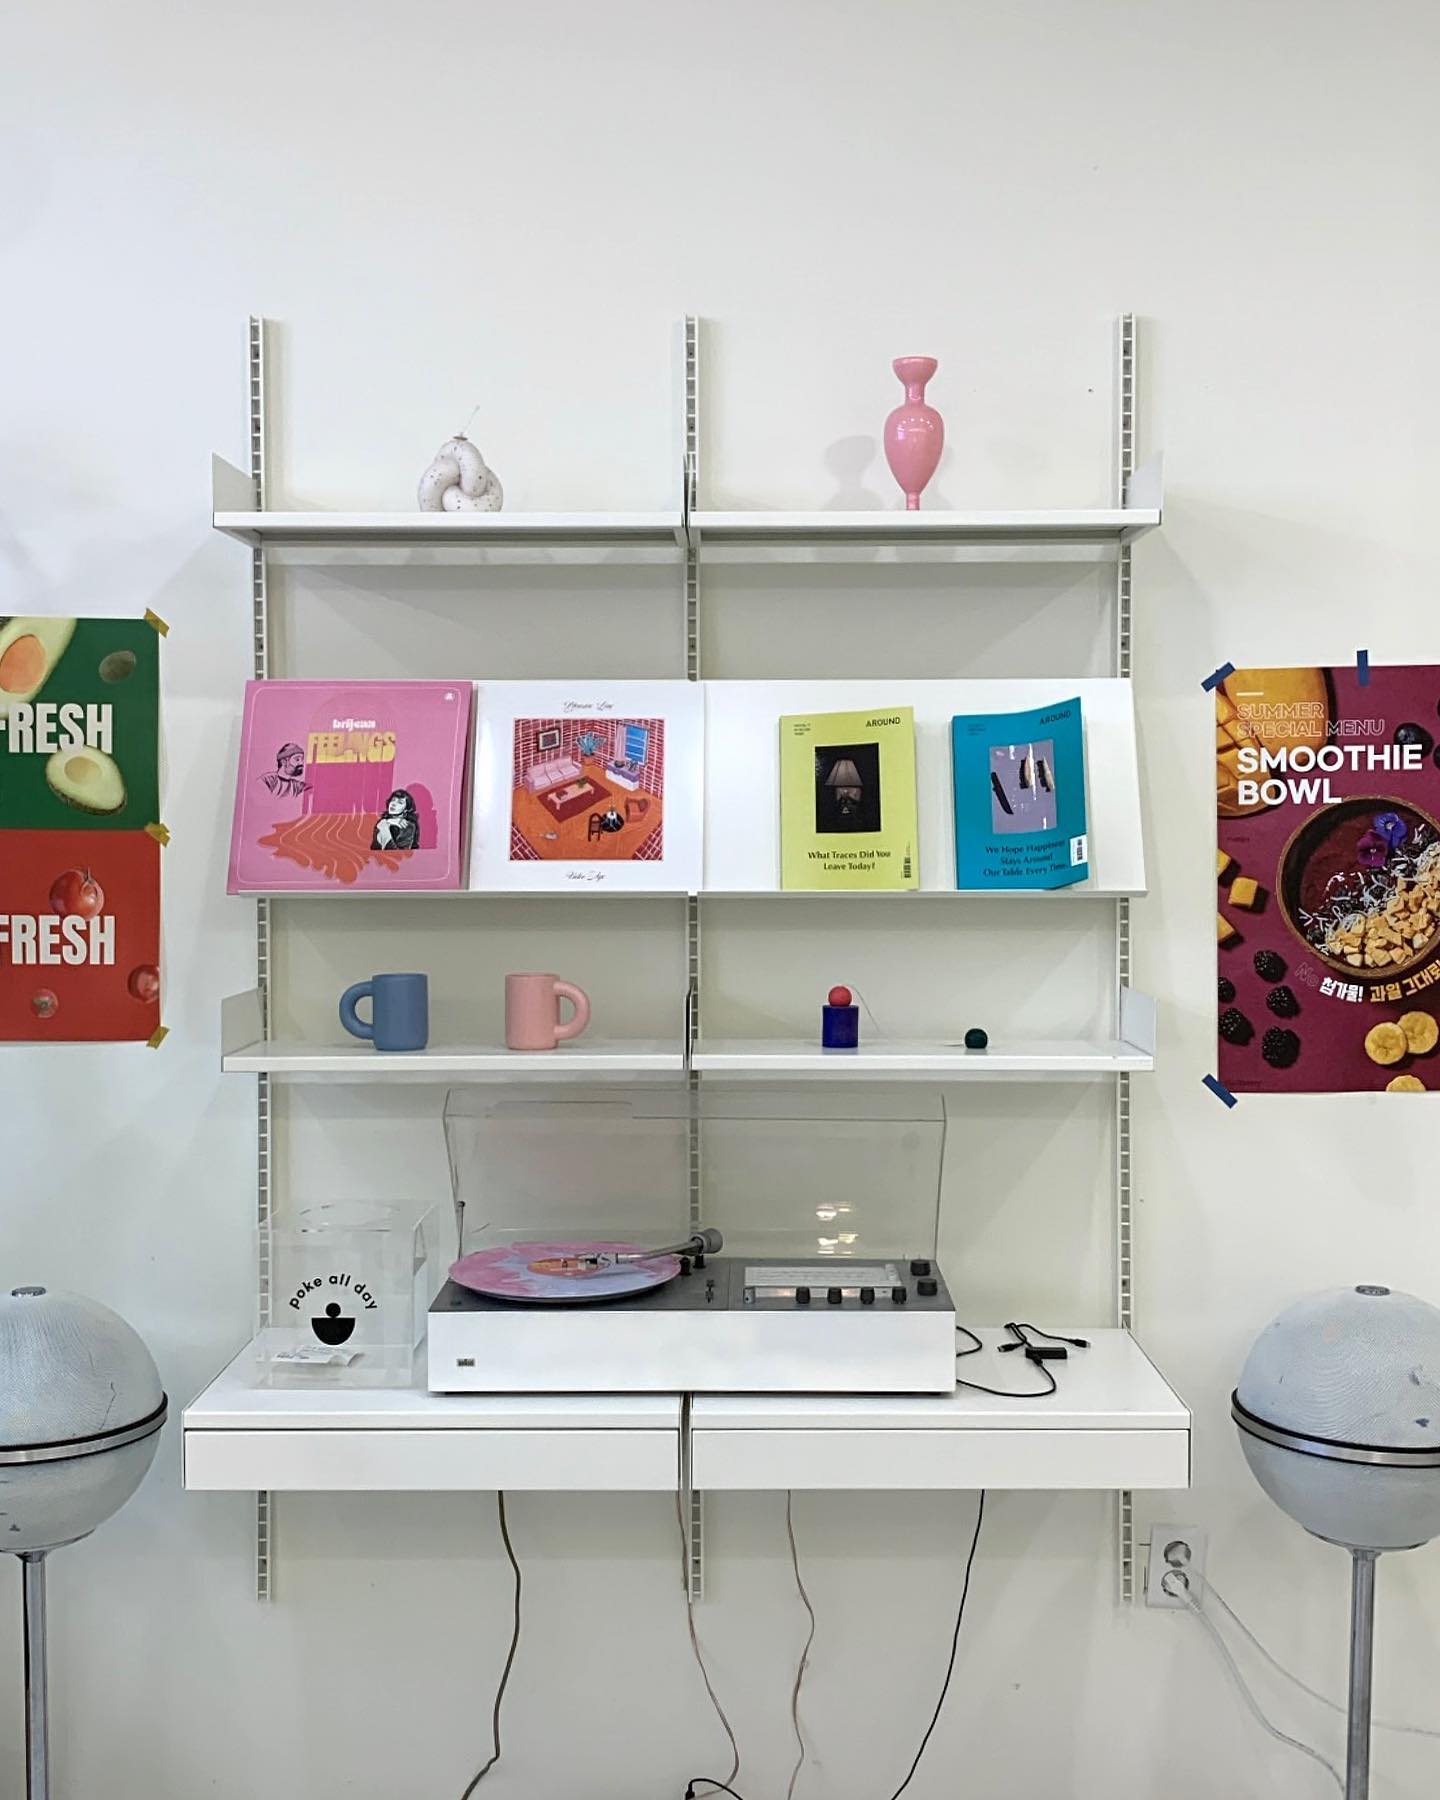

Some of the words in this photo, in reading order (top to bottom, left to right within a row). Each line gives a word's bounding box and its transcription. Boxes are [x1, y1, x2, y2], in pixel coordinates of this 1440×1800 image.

[1236, 701, 1325, 720] SUMMER
[0, 703, 112, 754] RESH
[865, 716, 901, 727] AROUND
[1236, 720, 1322, 738] SPECIAL
[1325, 719, 1386, 737] MENU
[1236, 743, 1423, 773] SMOOTHIE
[1237, 778, 1342, 806] BOWL
[807, 850, 830, 859] What
[831, 850, 858, 859] Traces
[859, 849, 875, 859] Did
[875, 849, 891, 858] You
[823, 862, 846, 871] Leave
[1370, 981, 1403, 1003] 과일
[289, 1276, 323, 1310] poke
[329, 1273, 351, 1287] all
[354, 1282, 378, 1310] day
